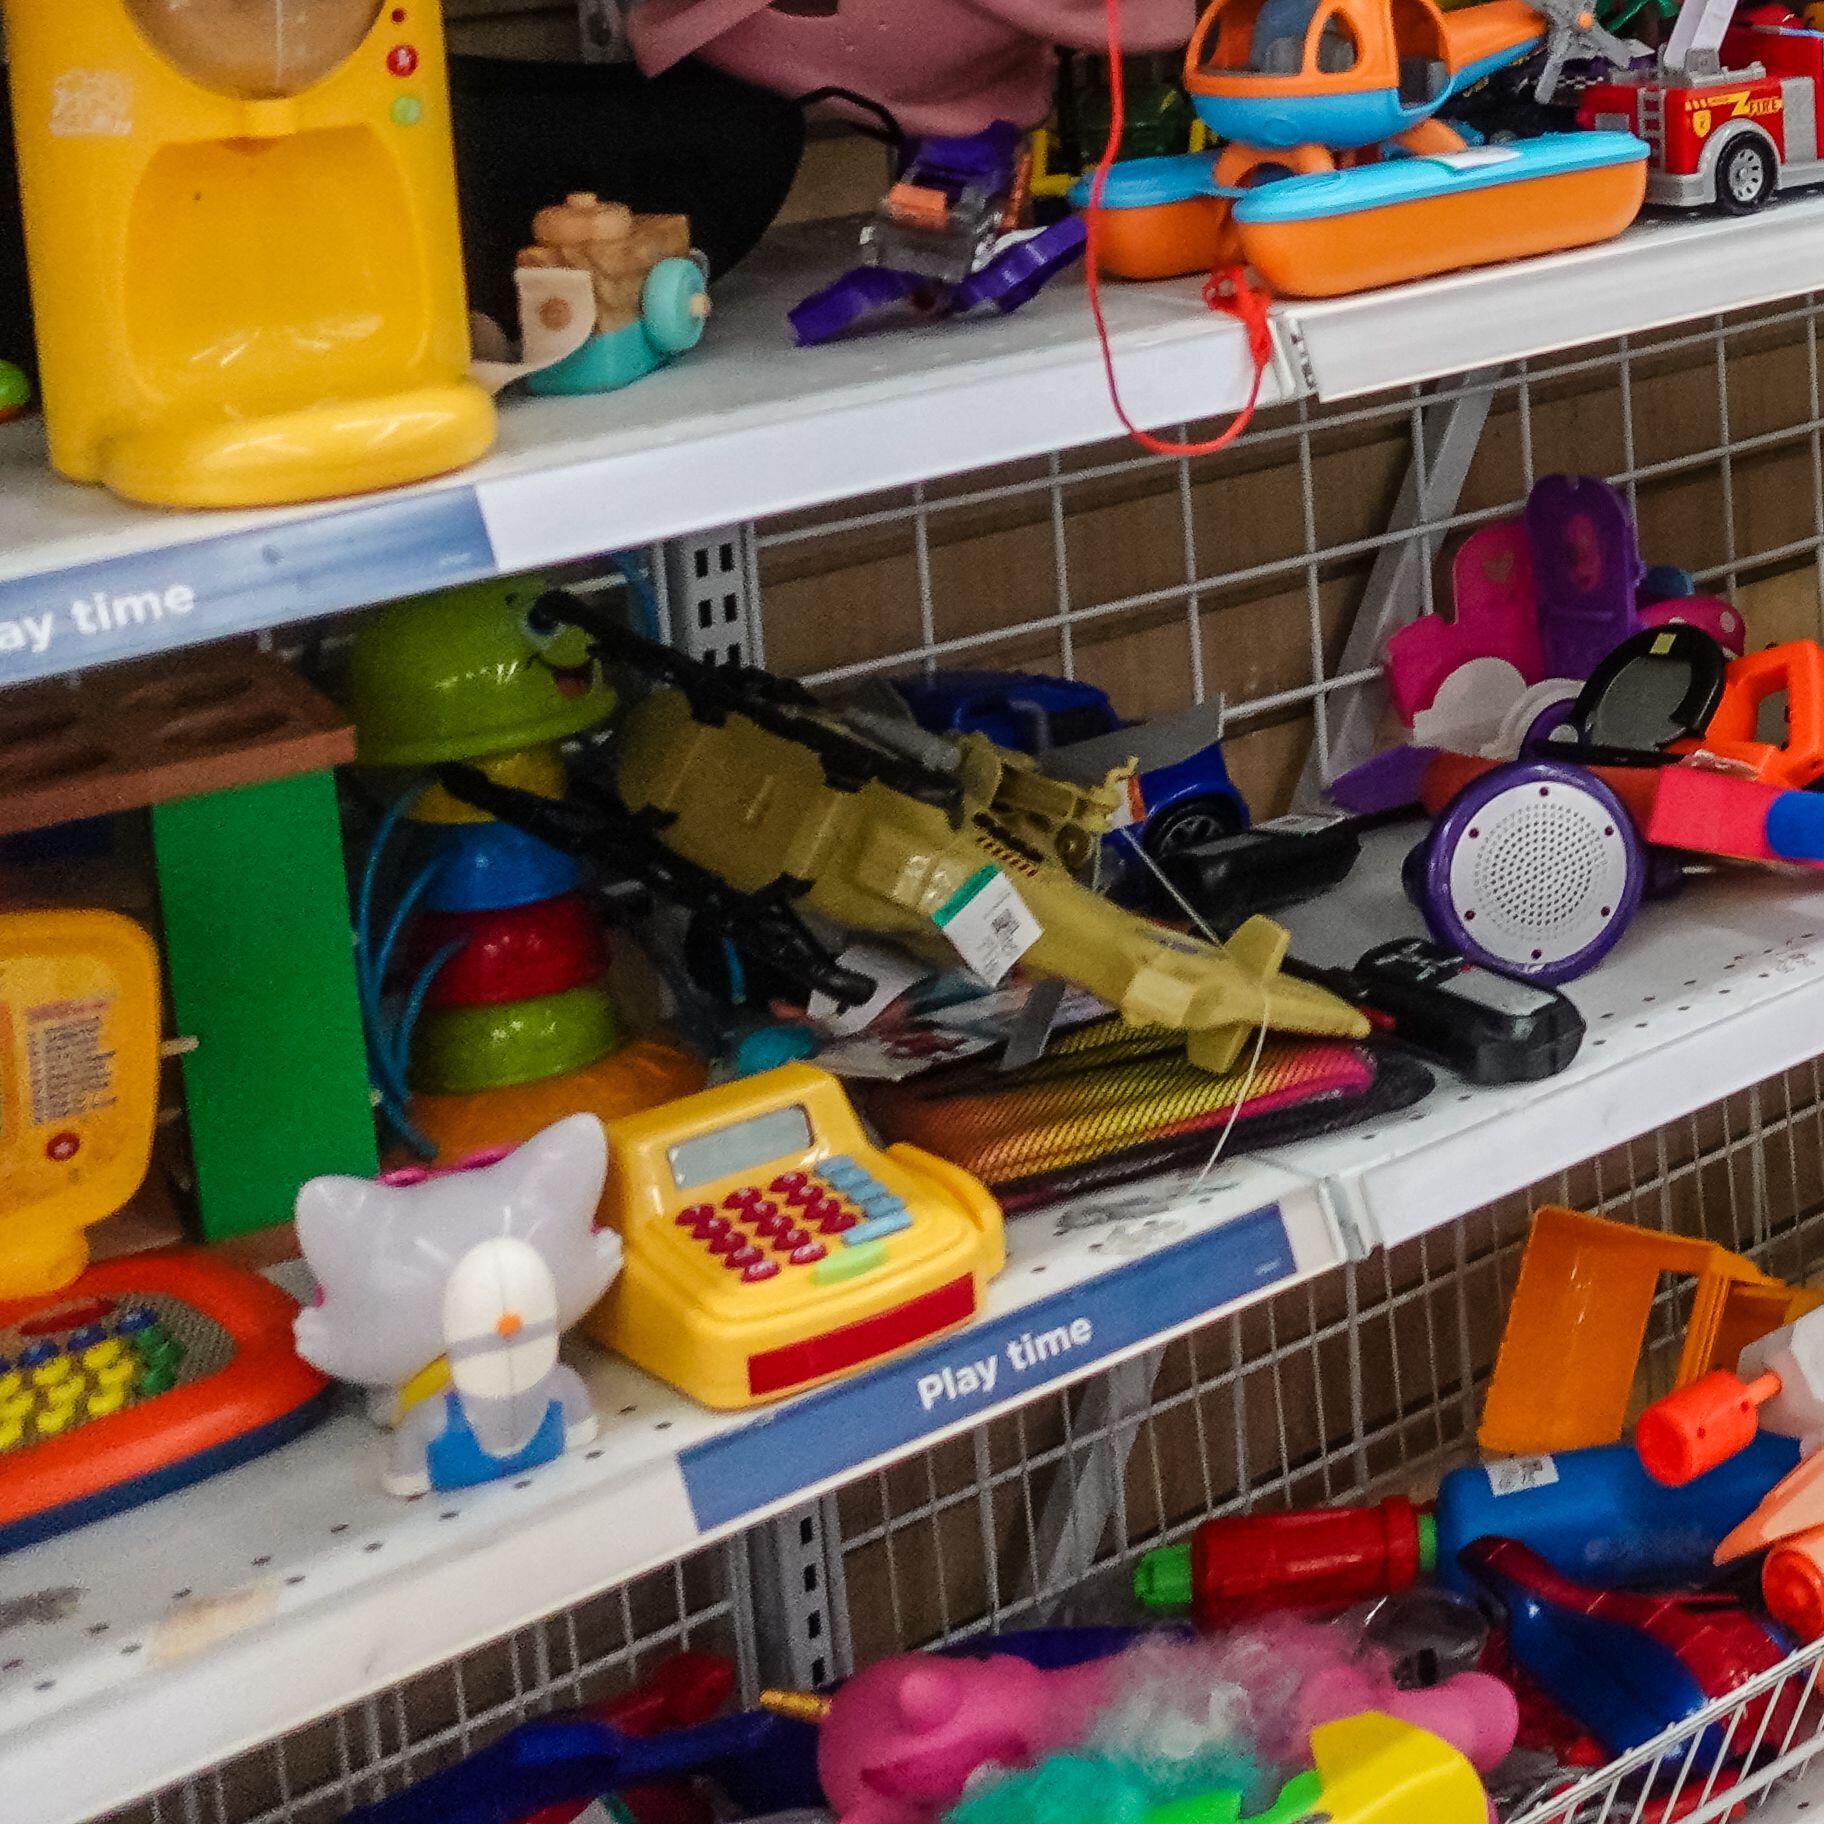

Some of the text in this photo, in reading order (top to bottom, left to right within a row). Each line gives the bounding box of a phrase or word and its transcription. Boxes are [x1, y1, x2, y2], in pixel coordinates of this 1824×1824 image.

[71, 583, 195, 636] time
[916, 1317, 1094, 1411] Play time
